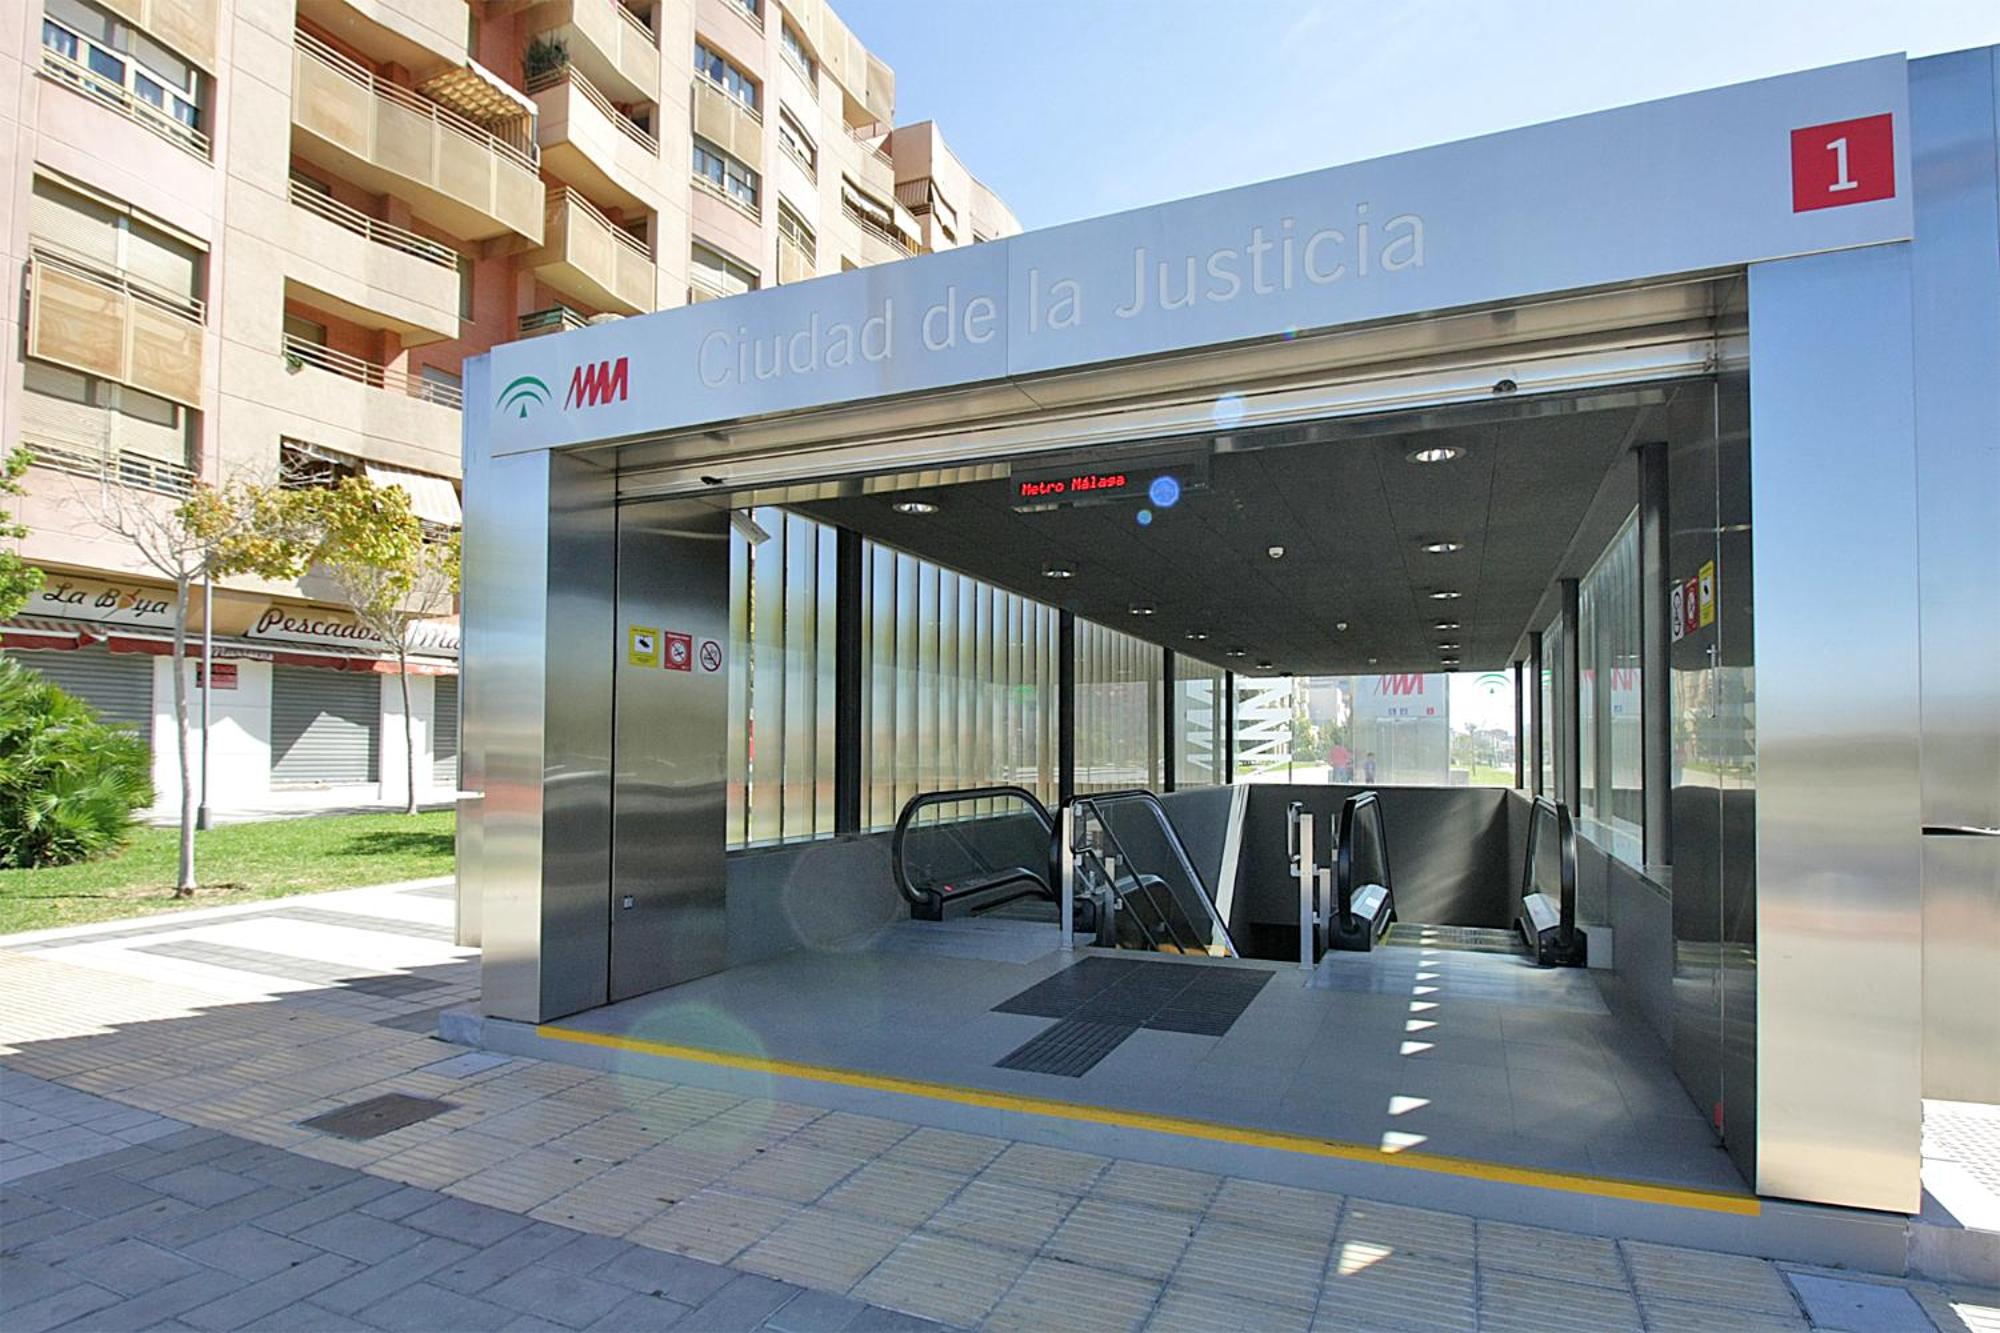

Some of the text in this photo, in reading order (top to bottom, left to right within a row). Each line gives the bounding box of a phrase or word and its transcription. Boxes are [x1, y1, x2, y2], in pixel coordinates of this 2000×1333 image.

[1826, 136, 1858, 193] 1
[697, 202, 1426, 388] Ciudad de la Justicia
[1021, 481, 1065, 497] Metro
[42, 582, 87, 604] La
[256, 607, 382, 642] Pescados
